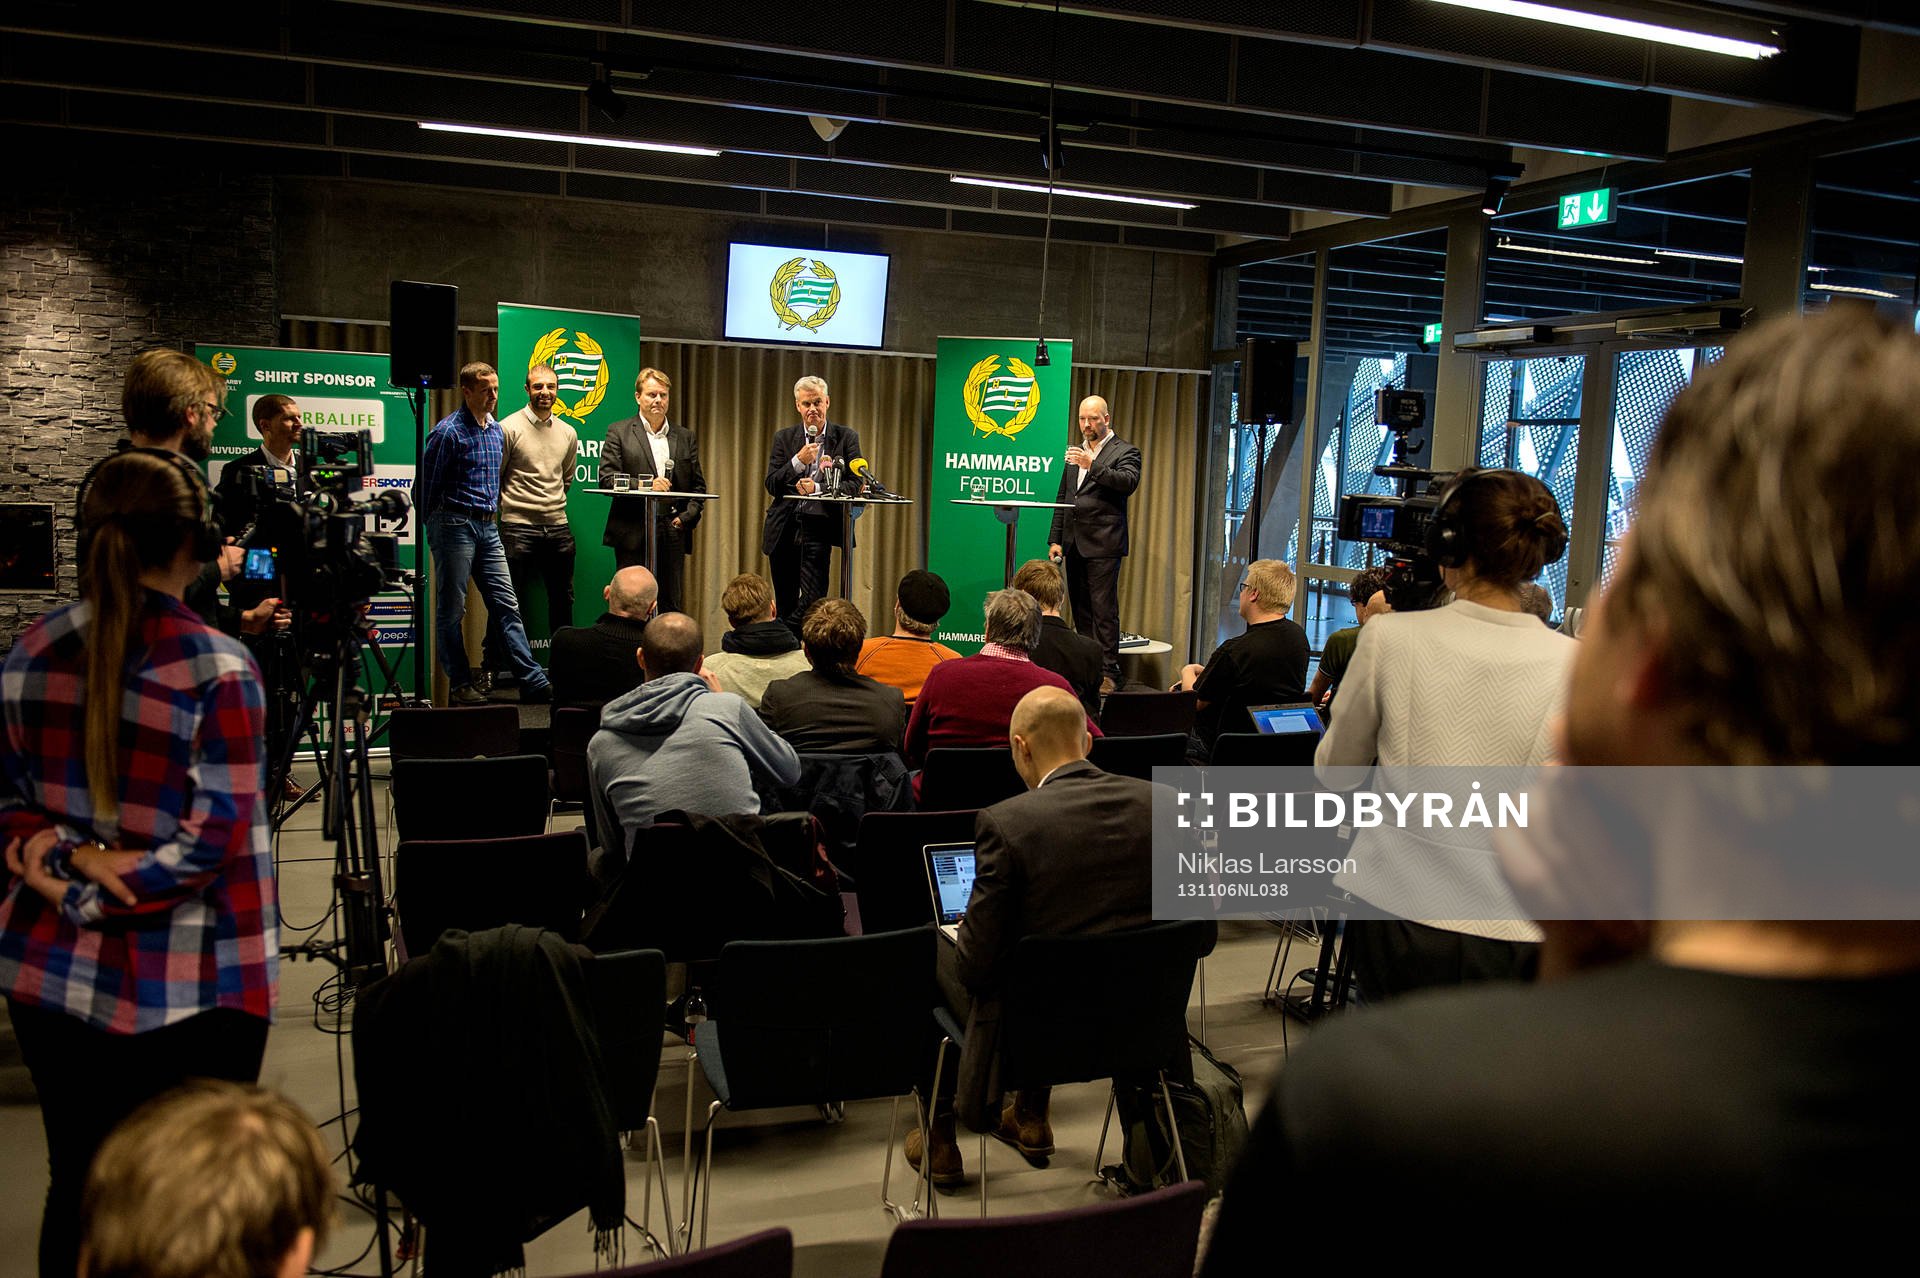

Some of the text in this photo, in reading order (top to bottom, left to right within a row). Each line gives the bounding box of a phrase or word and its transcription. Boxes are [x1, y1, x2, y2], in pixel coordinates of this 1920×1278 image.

[254, 370, 376, 387] SHIRT SPONSOR
[303, 411, 376, 427] RBALIFE
[945, 452, 1054, 473] HAMMARBY
[361, 478, 412, 488] ERSPORT
[960, 475, 1036, 495] FOTBOLL
